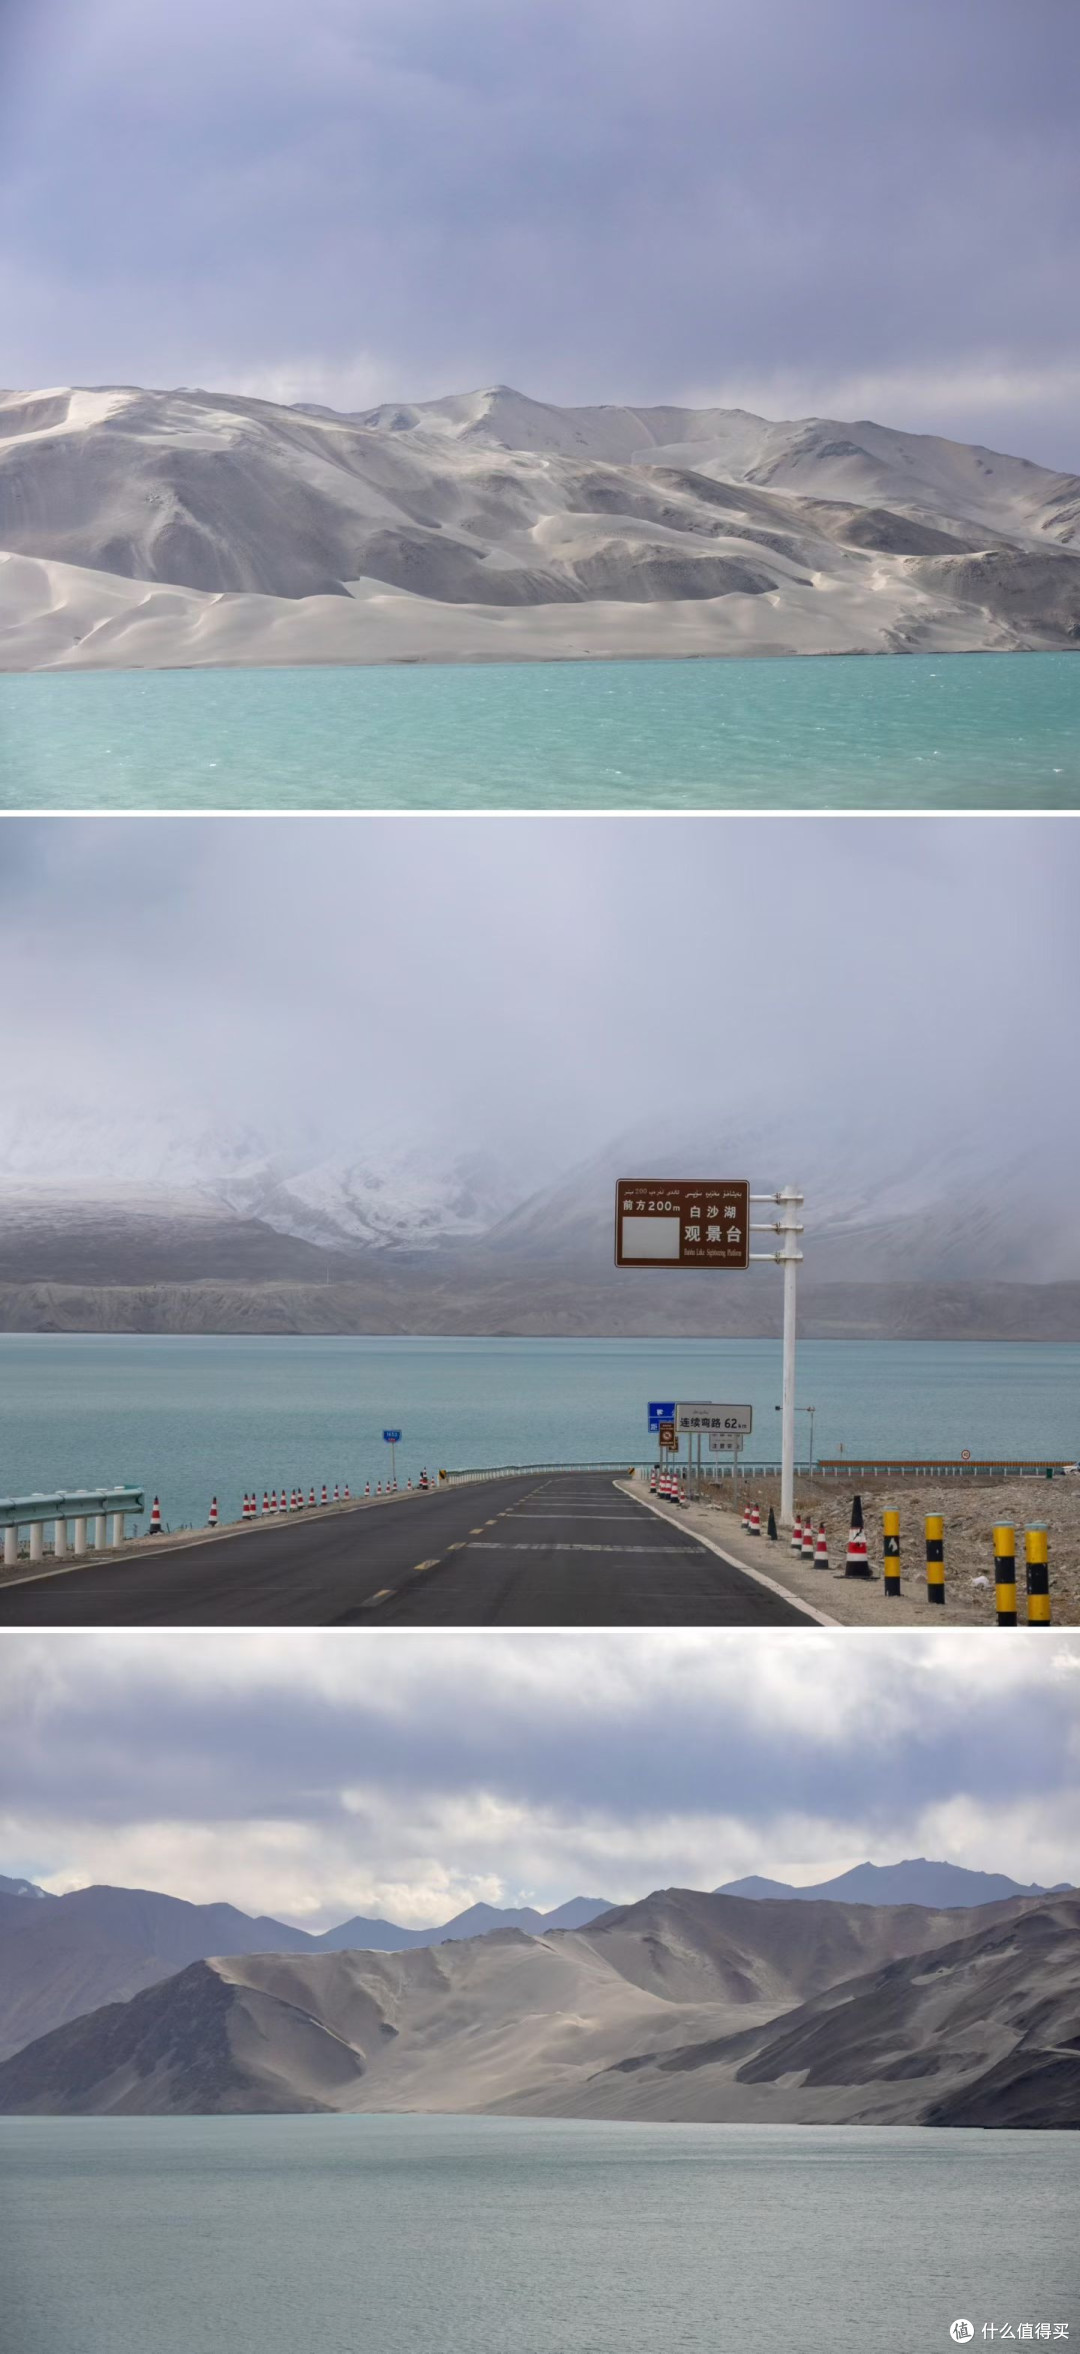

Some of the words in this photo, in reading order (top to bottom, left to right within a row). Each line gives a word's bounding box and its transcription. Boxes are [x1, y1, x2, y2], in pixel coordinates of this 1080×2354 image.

[623, 1200, 680, 1211] 前方200m
[690, 1205, 736, 1218] 白沙湖
[684, 1225, 742, 1243] 观景台
[680, 1417, 721, 1428] 连续弯路
